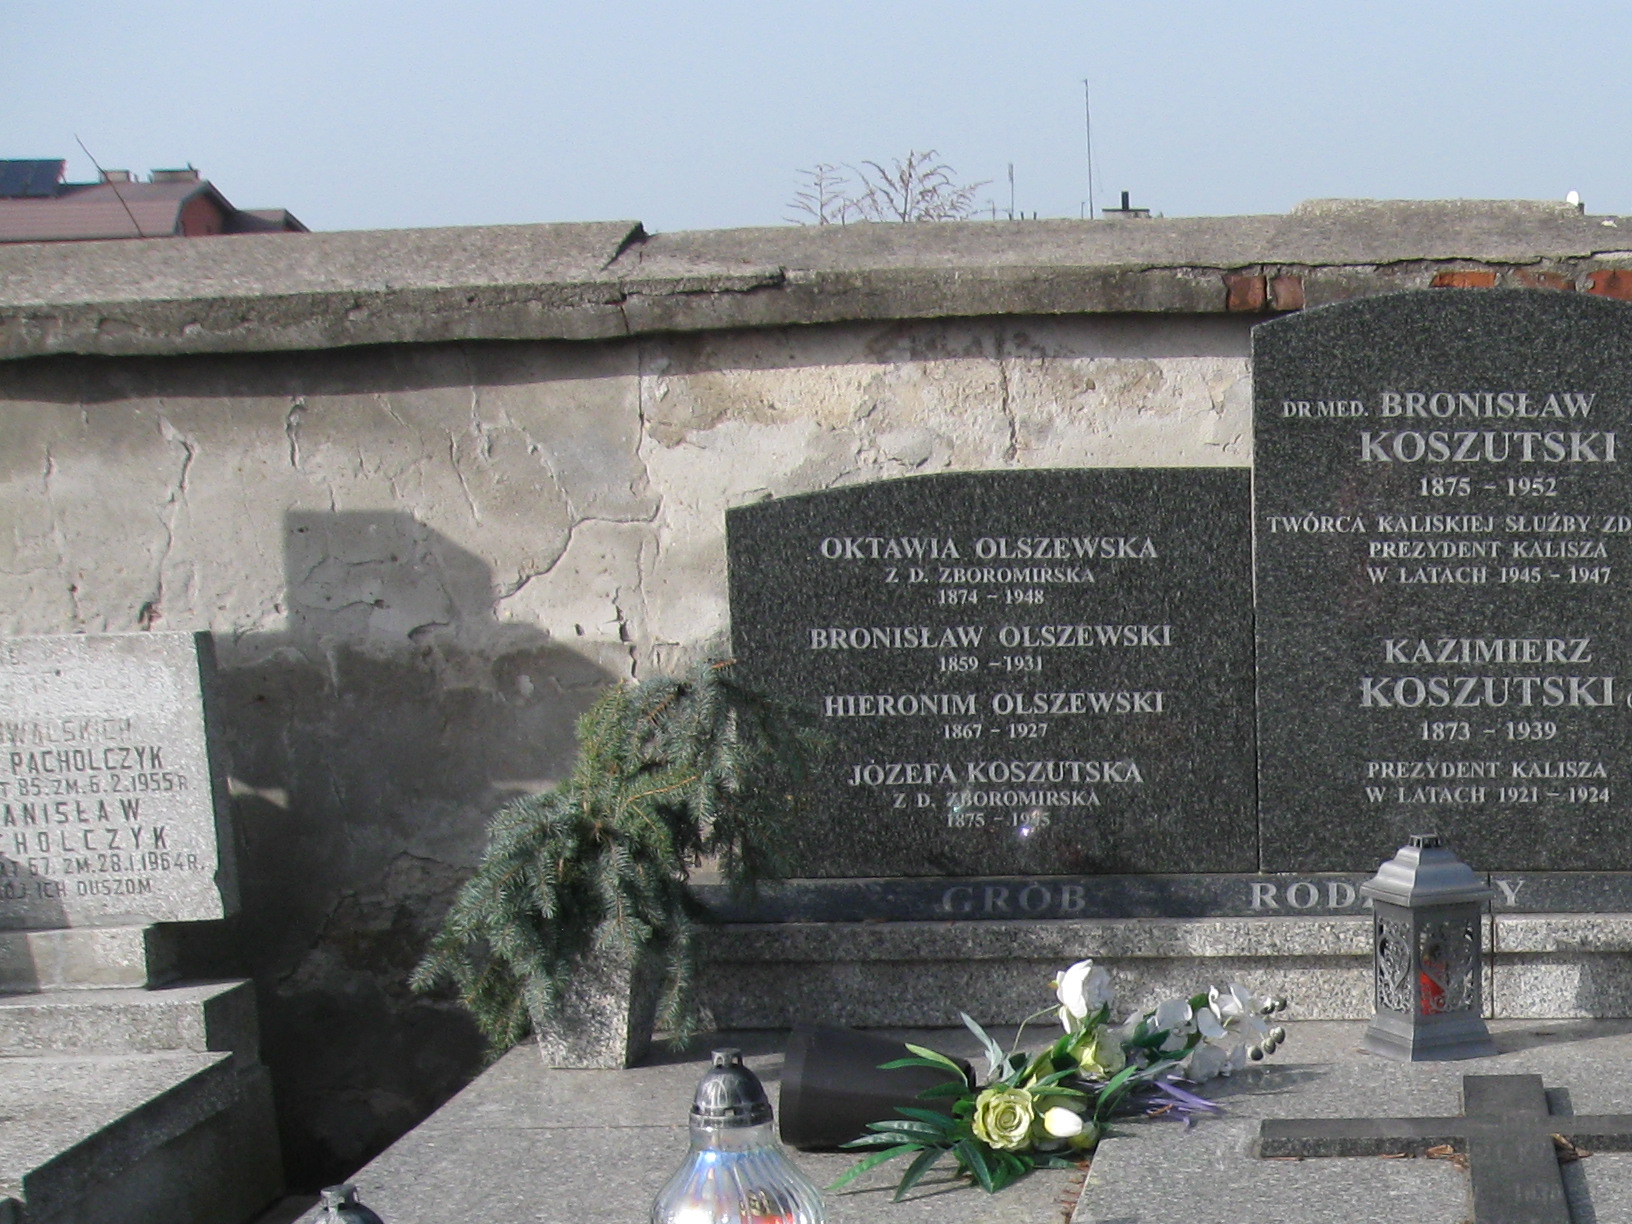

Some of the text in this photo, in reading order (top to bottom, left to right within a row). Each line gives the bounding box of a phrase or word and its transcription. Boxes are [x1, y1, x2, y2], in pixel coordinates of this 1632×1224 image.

[1282, 392, 1596, 419] DR MED. BRONISŁAW
[1360, 430, 1618, 463] KOSZUTSKI
[1419, 477, 1471, 497] 1875
[1506, 477, 1558, 497] 1952
[1266, 511, 1367, 534] TWÓRCA
[1377, 515, 1494, 534] KALISKIEJ
[1505, 511, 1590, 533] SŁUŻBY
[820, 535, 1159, 560] OKTAWIA OLSZEWSKA
[1368, 540, 1609, 558] PREZYDENT KALISZA
[885, 566, 1096, 584] Z D. ZBOROMIRSKA
[1366, 566, 1389, 584] W
[1399, 566, 1488, 584] LATACH
[1500, 566, 1542, 584] 1945
[1569, 566, 1612, 584] 1947
[939, 588, 978, 605] 1874
[1005, 588, 1045, 605] 1948
[809, 624, 1173, 650] BRONISŁAW OLSZEWSKI
[1384, 638, 1593, 664] KAZIMIERZ
[939, 656, 979, 673] 1859
[1004, 655, 1044, 672] 1931
[1358, 675, 1615, 708] KOSZUTSKI
[824, 691, 1165, 718] HIERONIM OLSZEWSKI
[943, 722, 982, 740] 1867
[1008, 721, 1049, 739] 1927
[1419, 720, 1471, 742] 1873
[1506, 720, 1557, 742] 1939
[10, 746, 163, 777] PACHOLCZYK
[848, 758, 1145, 787] JÓZEFA KOSZUTSKA
[1367, 760, 1608, 778] PREZYDENT KALISZA
[893, 789, 1101, 808] Z D. ZBOROMIRSKA
[1365, 786, 1387, 803] W
[1398, 786, 1487, 803] LATACH
[1498, 786, 1539, 803] 1921
[1567, 785, 1611, 803] 1924
[947, 811, 986, 828] 1875
[0, 826, 168, 855] HOLCZYK
[942, 880, 1087, 913] GRÓB
[1251, 879, 1524, 911] RODY
